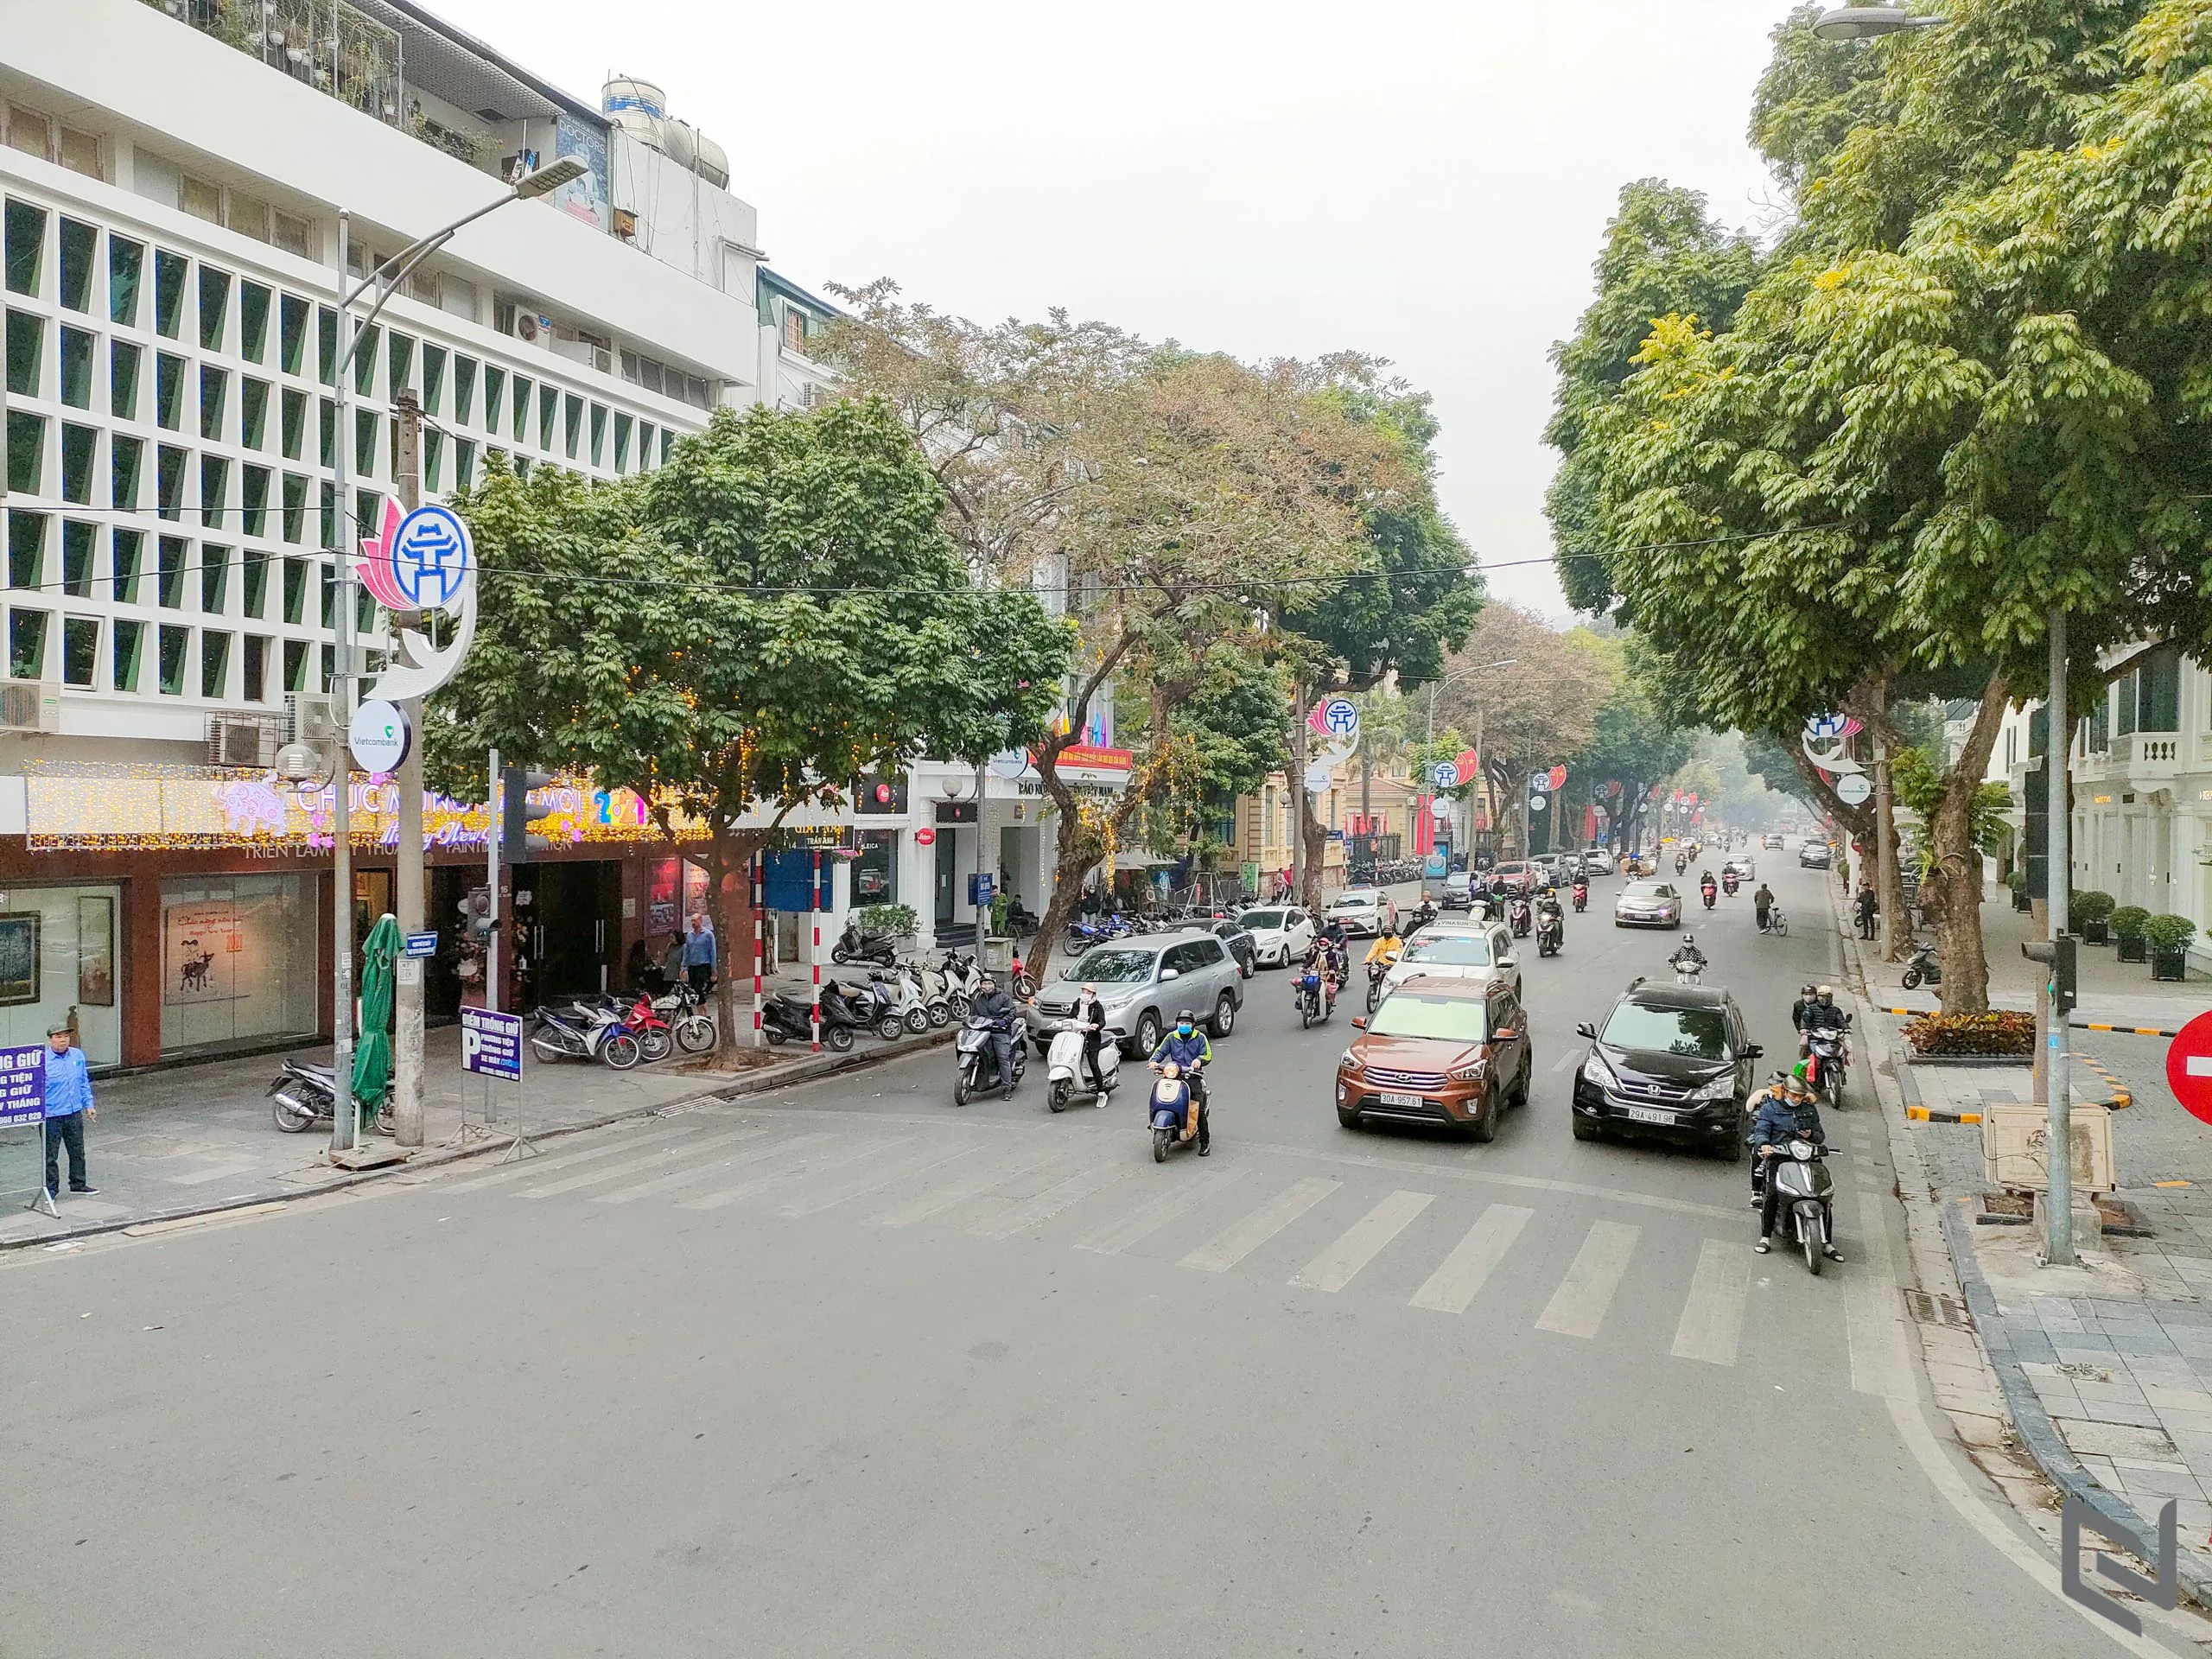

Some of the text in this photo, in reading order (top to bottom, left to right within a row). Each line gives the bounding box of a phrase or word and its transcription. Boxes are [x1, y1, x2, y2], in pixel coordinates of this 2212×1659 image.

[559, 119, 606, 155] DOCTORS
[353, 736, 399, 747] Vietcombank
[386, 785, 468, 813] MNG
[380, 819, 434, 851] Hay
[461, 1027, 481, 1069] P
[17, 1049, 42, 1067] GIỮ
[10, 1071, 33, 1084] TIỆN
[10, 1084, 33, 1096] GIỮ
[7, 1096, 41, 1110] THÁNG
